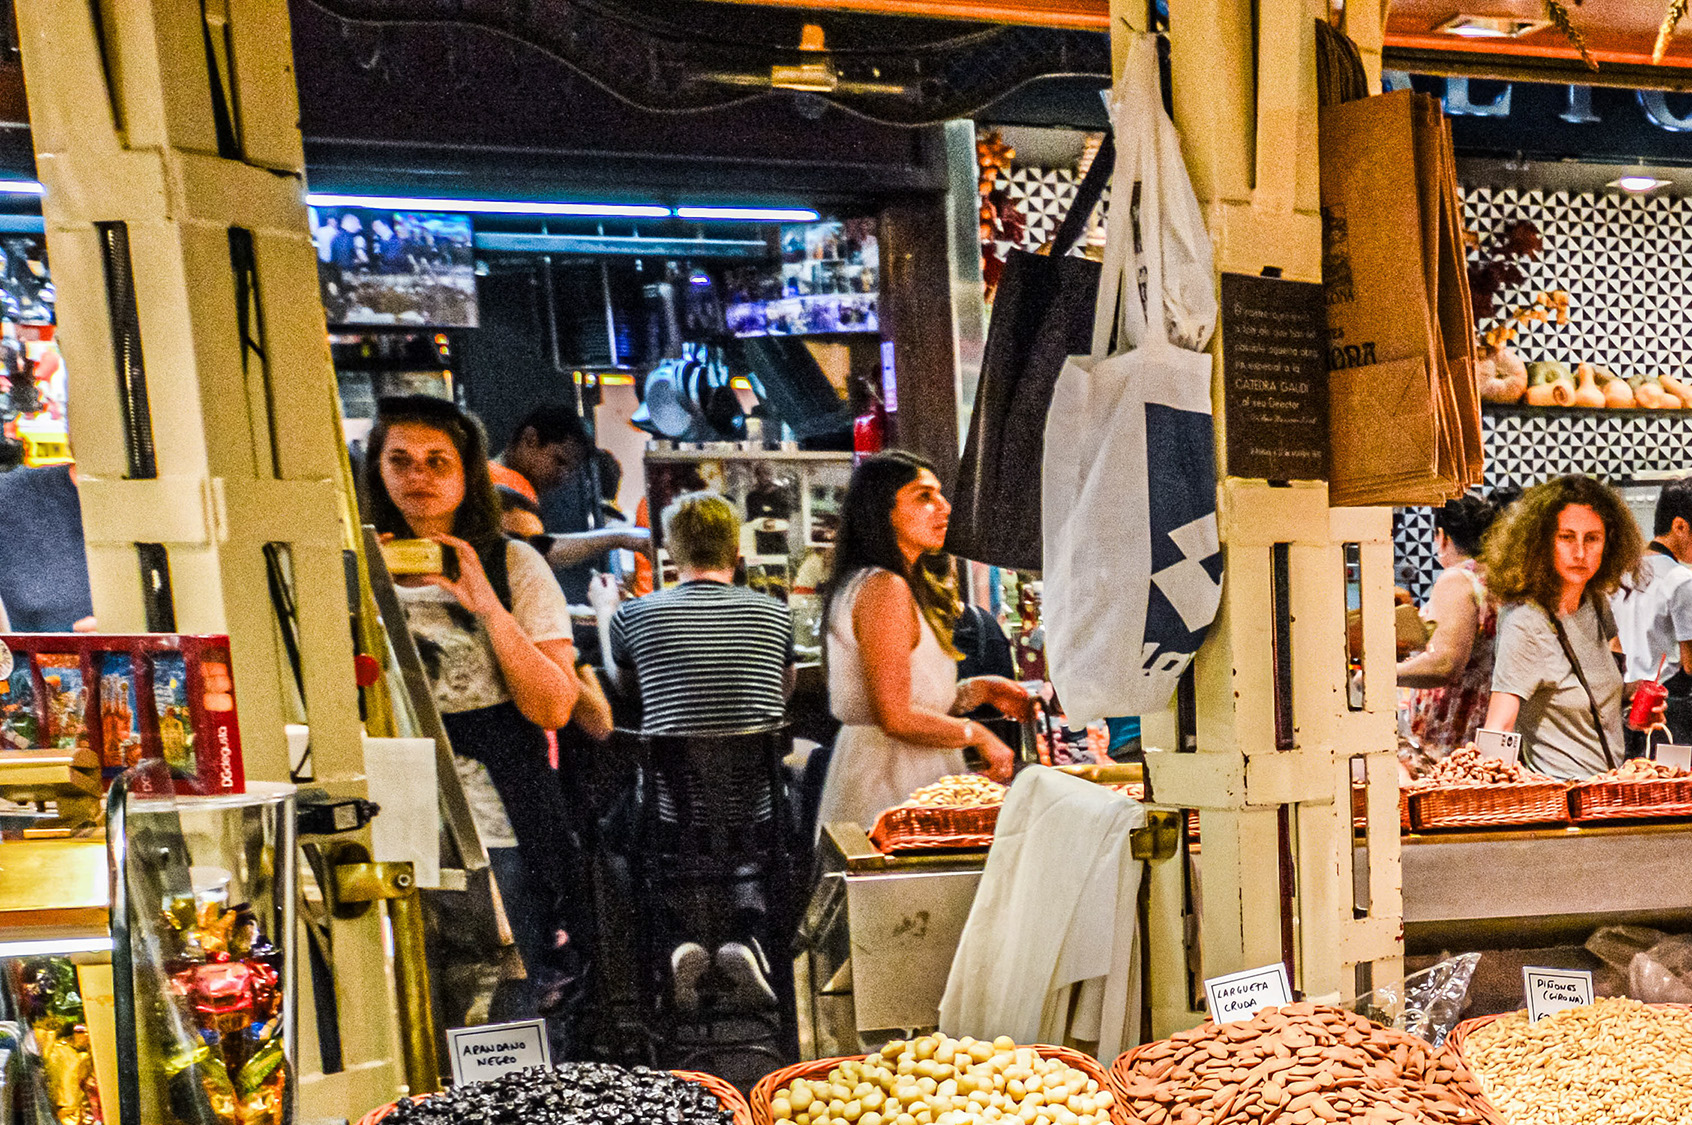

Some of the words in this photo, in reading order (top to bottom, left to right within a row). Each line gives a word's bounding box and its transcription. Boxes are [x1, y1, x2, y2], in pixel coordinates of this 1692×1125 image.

[1217, 981, 1269, 999] LARGUETA
[1224, 998, 1258, 1013] CRUDA
[476, 1056, 518, 1067] NEGRO
